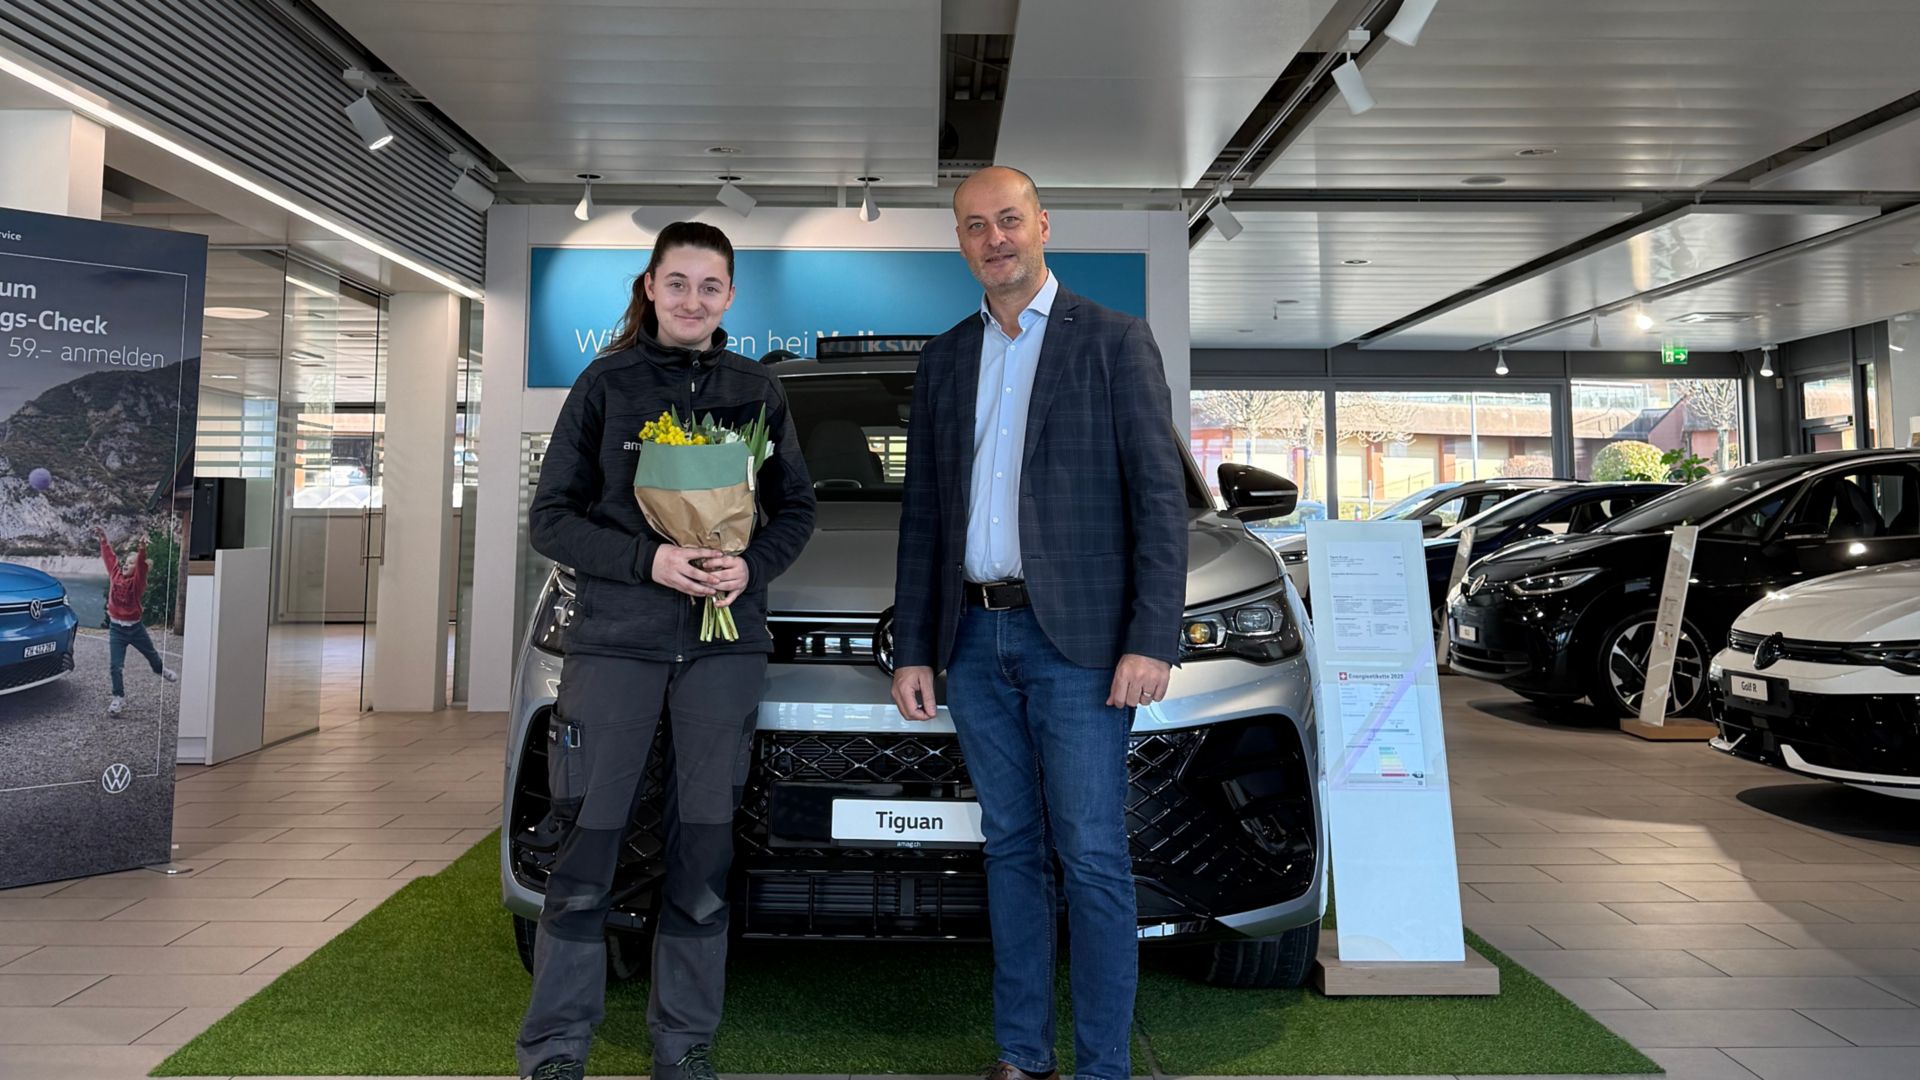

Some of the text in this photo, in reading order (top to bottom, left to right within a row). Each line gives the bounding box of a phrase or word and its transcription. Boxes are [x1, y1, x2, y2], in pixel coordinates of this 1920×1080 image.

[768, 329, 809, 354] bei
[61, 345, 164, 368] anmelden
[623, 441, 642, 451] am
[1752, 683, 1757, 692] R
[876, 811, 943, 833] Tiguan
